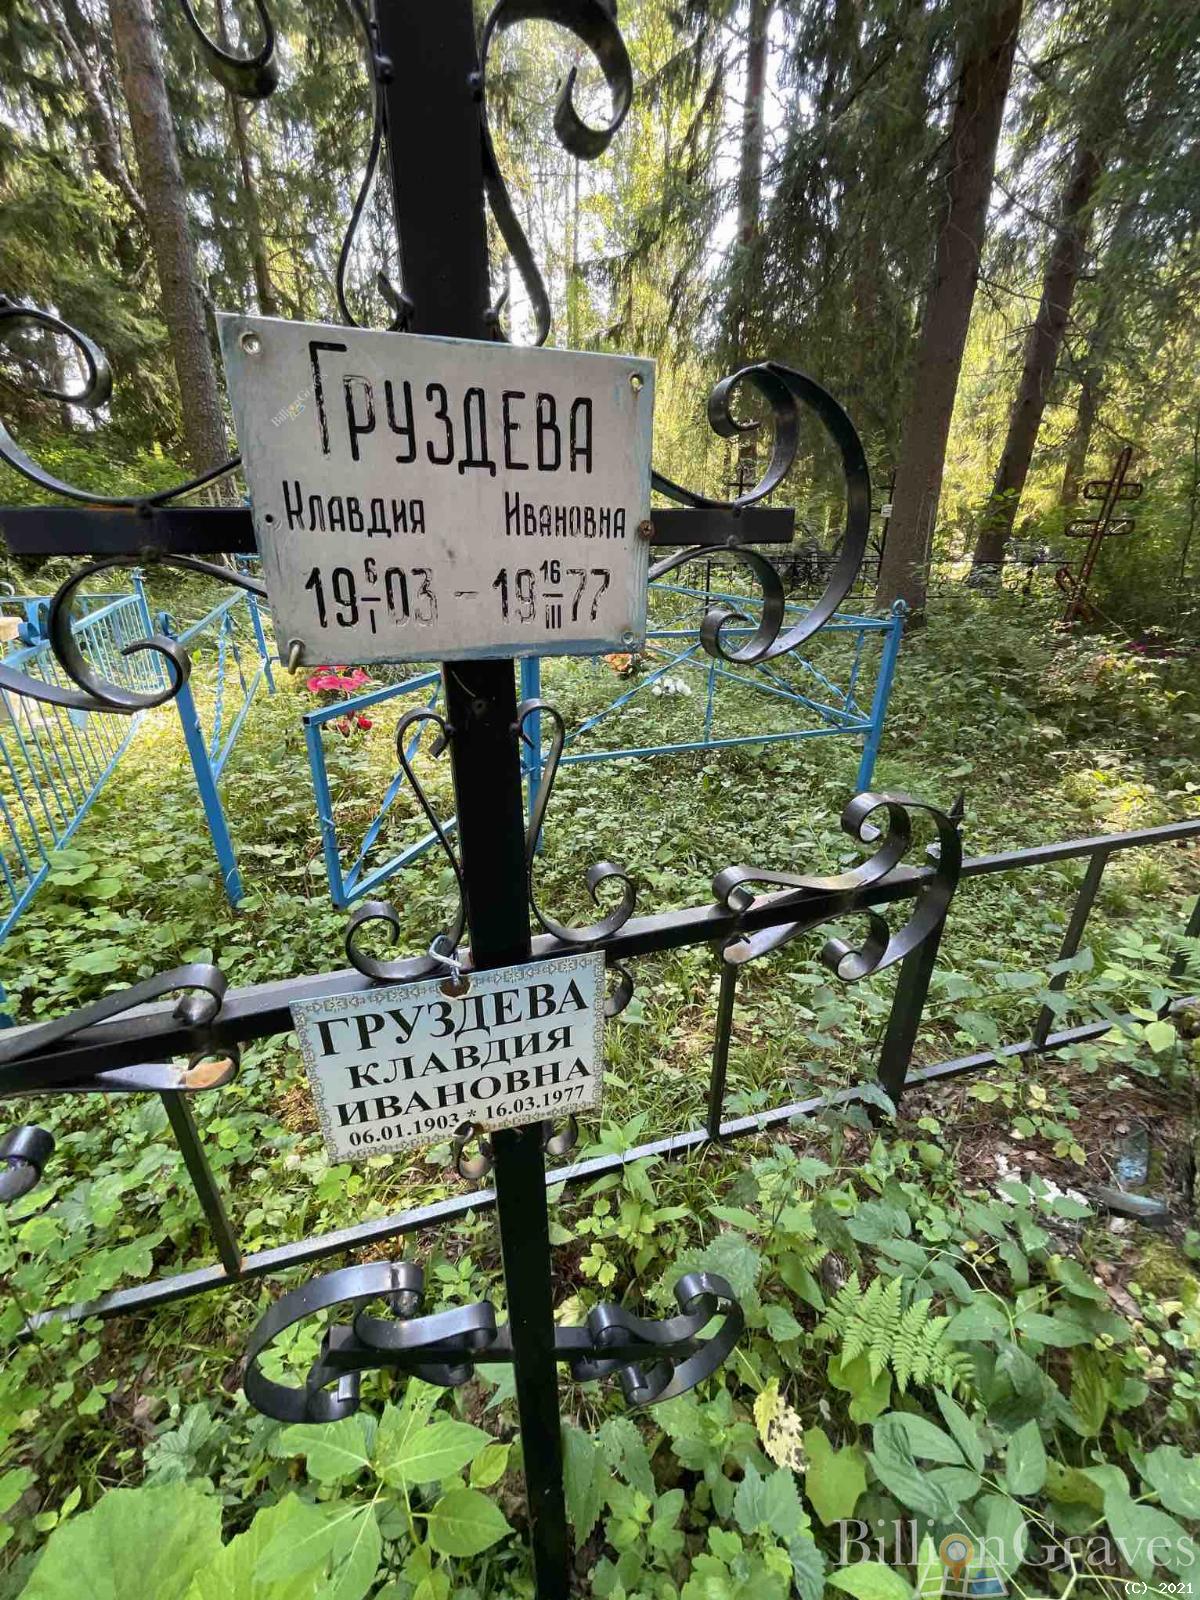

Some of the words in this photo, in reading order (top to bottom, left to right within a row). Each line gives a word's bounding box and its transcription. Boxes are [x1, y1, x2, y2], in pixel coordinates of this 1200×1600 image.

[315, 978, 589, 1057] ГРУЗДЕВА
[345, 1024, 574, 1090] КЛАВДИЯ
[333, 1057, 592, 1128] ИВАНОВНА
[349, 1112, 460, 1147] 06.01.1903
[486, 1084, 585, 1119] 16.03.1977
